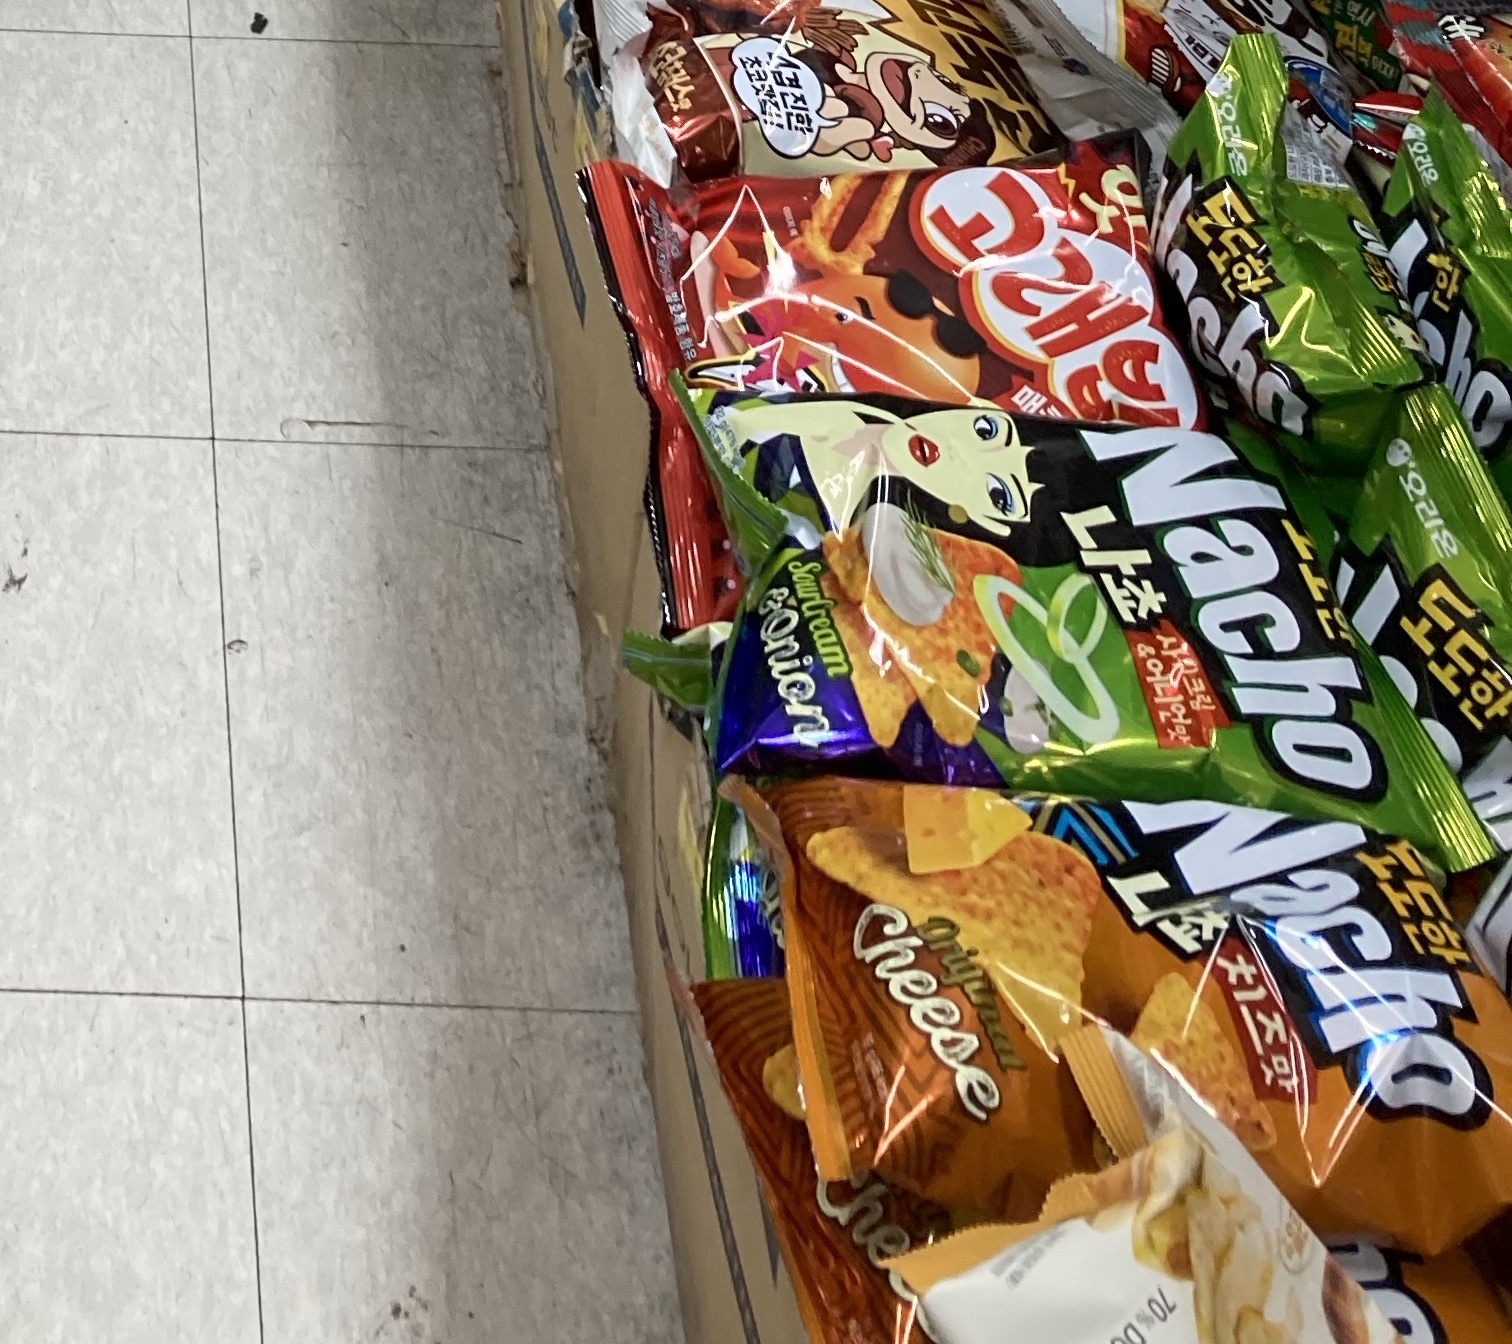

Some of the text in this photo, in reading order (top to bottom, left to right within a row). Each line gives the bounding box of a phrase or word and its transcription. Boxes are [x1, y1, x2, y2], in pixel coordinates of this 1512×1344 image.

[1190, 178, 1281, 299] 도도한
[1061, 508, 1169, 626] 나쵸
[1081, 427, 1373, 791] Nacho
[1129, 800, 1486, 1118] Nacho
[1352, 840, 1472, 966] 도도한
[852, 900, 1001, 1124] Cheese
[1214, 950, 1302, 1098] 치즈맛
